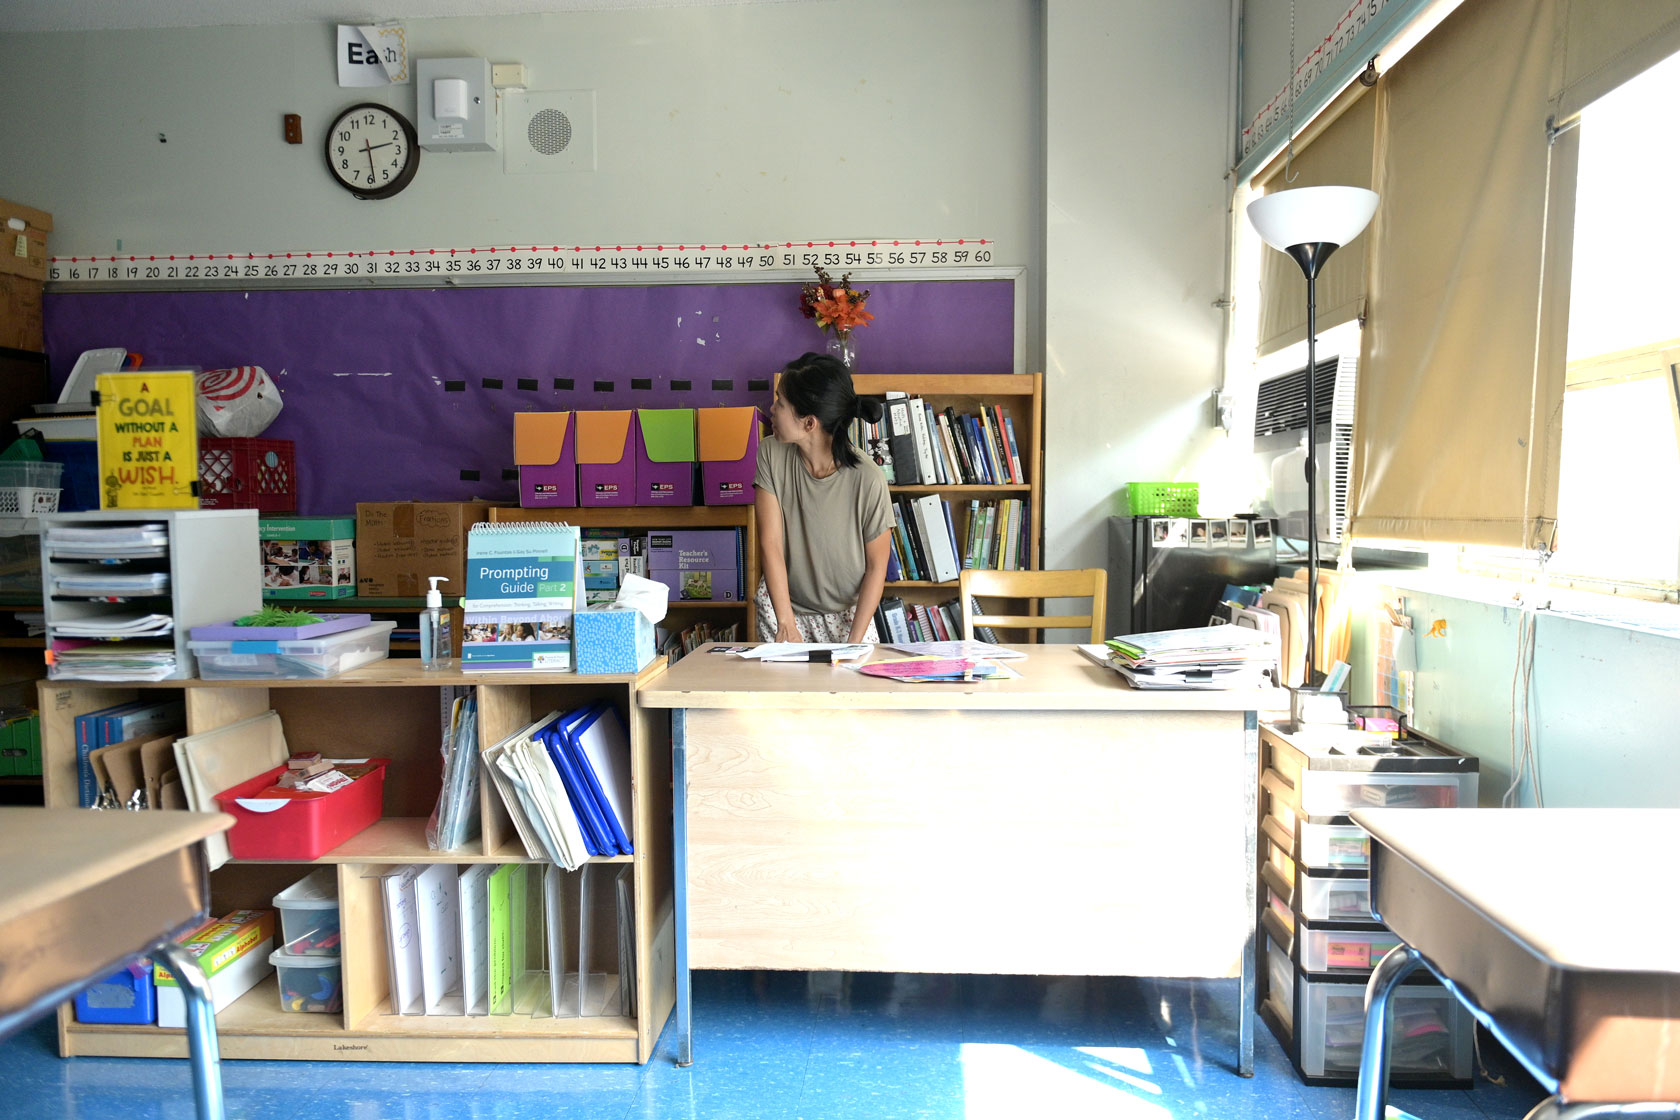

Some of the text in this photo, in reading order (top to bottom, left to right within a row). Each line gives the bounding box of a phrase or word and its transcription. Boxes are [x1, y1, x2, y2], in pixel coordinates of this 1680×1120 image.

[1346, 25, 1354, 46] 73
[1357, 12, 1366, 32] 74
[350, 120, 359, 130] 11
[364, 115, 375, 125] 12
[382, 119, 387, 129] 1
[339, 131, 350, 141] 10
[392, 130, 399, 140] 2
[338, 146, 344, 156] 9
[395, 145, 402, 155] 3
[342, 159, 349, 169] 8
[391, 158, 398, 168] 4
[354, 170, 360, 180] 7
[367, 174, 374, 184] 6
[383, 170, 389, 179] 5
[49, 250, 992, 280] 15 16 17 18 19 20 21 22 23 24 25 26 27 28 29 30 31 32 33 34 35 36 37 38 39 40 41 42 43 44 45 46 47 48 49 50 51 52 53 54 55 56 57 58 59 60
[140, 382, 149, 393] A
[118, 398, 174, 416] GOAL
[114, 422, 178, 433] WITHOUT A
[132, 437, 162, 447] PLAN
[123, 451, 172, 462] IS JUST A
[118, 466, 179, 485] WISH.
[480, 566, 549, 581] Prompting
[501, 582, 534, 593] Guide
[539, 584, 557, 592] Part
[466, 616, 497, 624] Within
[501, 615, 537, 624] Beyond
[236, 935, 258, 952] Alphabet
